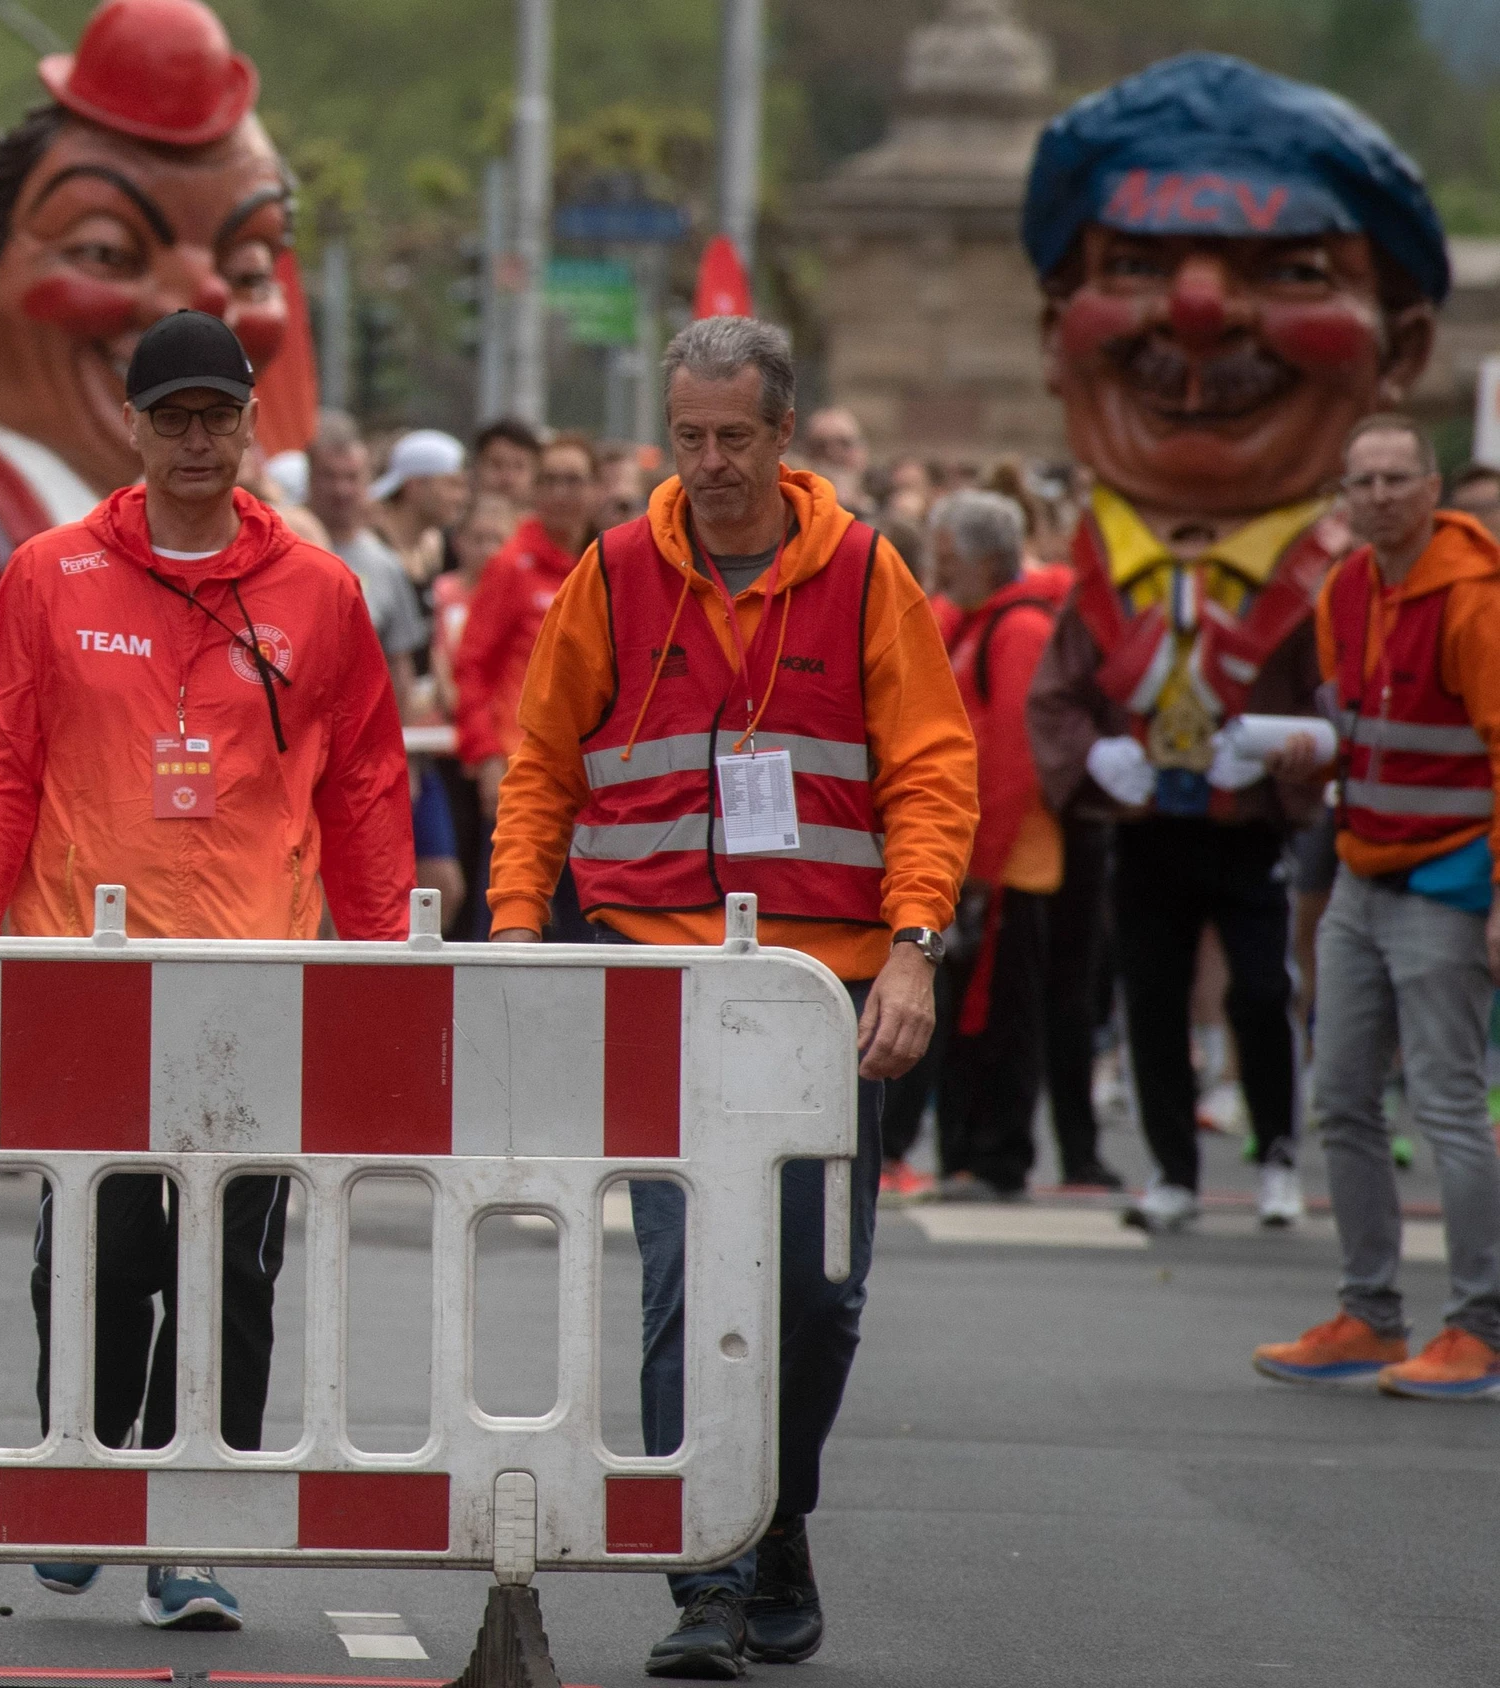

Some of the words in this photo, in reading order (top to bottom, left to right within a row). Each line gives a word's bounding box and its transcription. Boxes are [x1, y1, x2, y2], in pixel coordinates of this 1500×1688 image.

[1103, 168, 1289, 231] MCV
[76, 630, 152, 658] TEAM
[779, 655, 825, 674] HOKA
